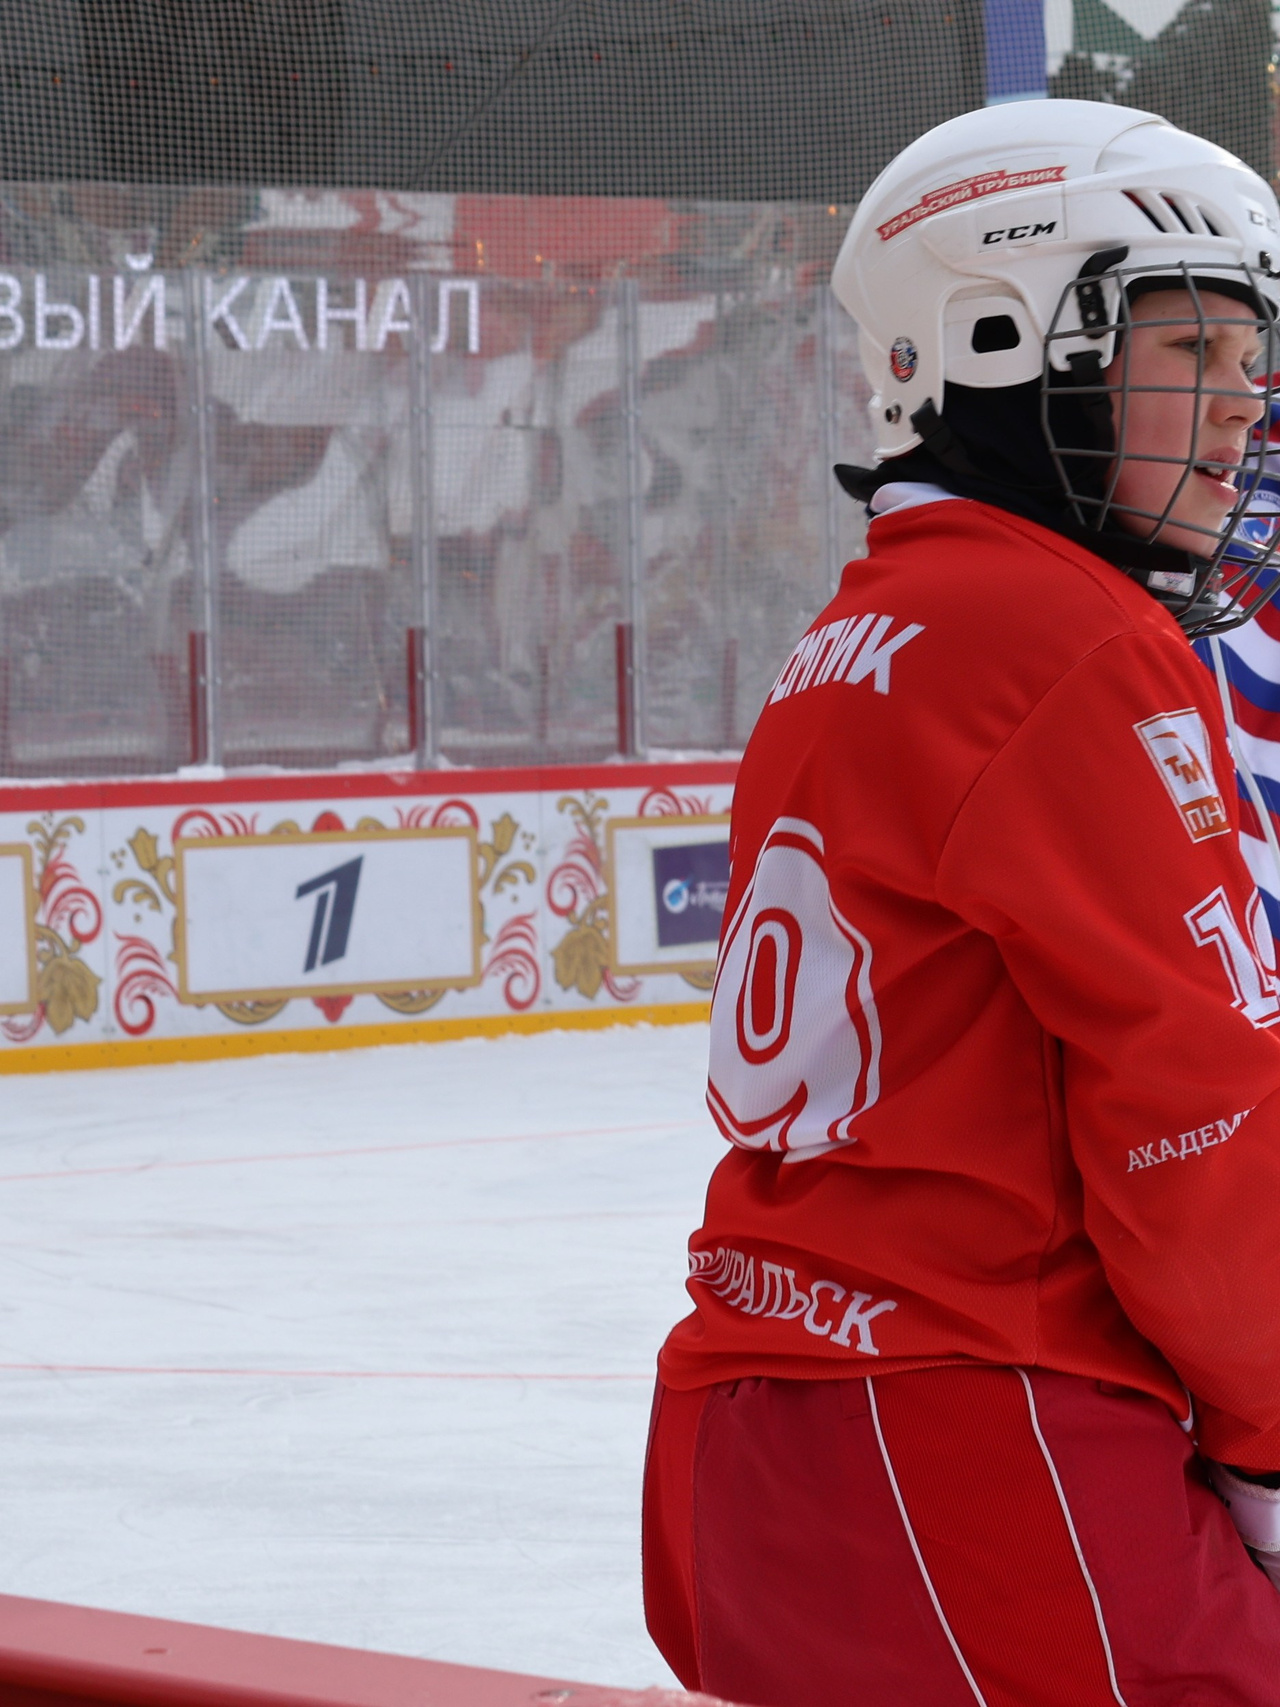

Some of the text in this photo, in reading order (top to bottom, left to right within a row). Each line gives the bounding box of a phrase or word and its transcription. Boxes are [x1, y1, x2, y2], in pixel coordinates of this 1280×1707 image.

[882, 168, 1058, 237] УРАЛЬСКИЙ ТРУБНИК
[982, 221, 1058, 245] CCM
[205, 276, 480, 353] КАНАЛ
[771, 613, 927, 706] ОМПИК
[1127, 1105, 1257, 1172] АКАДЕМ
